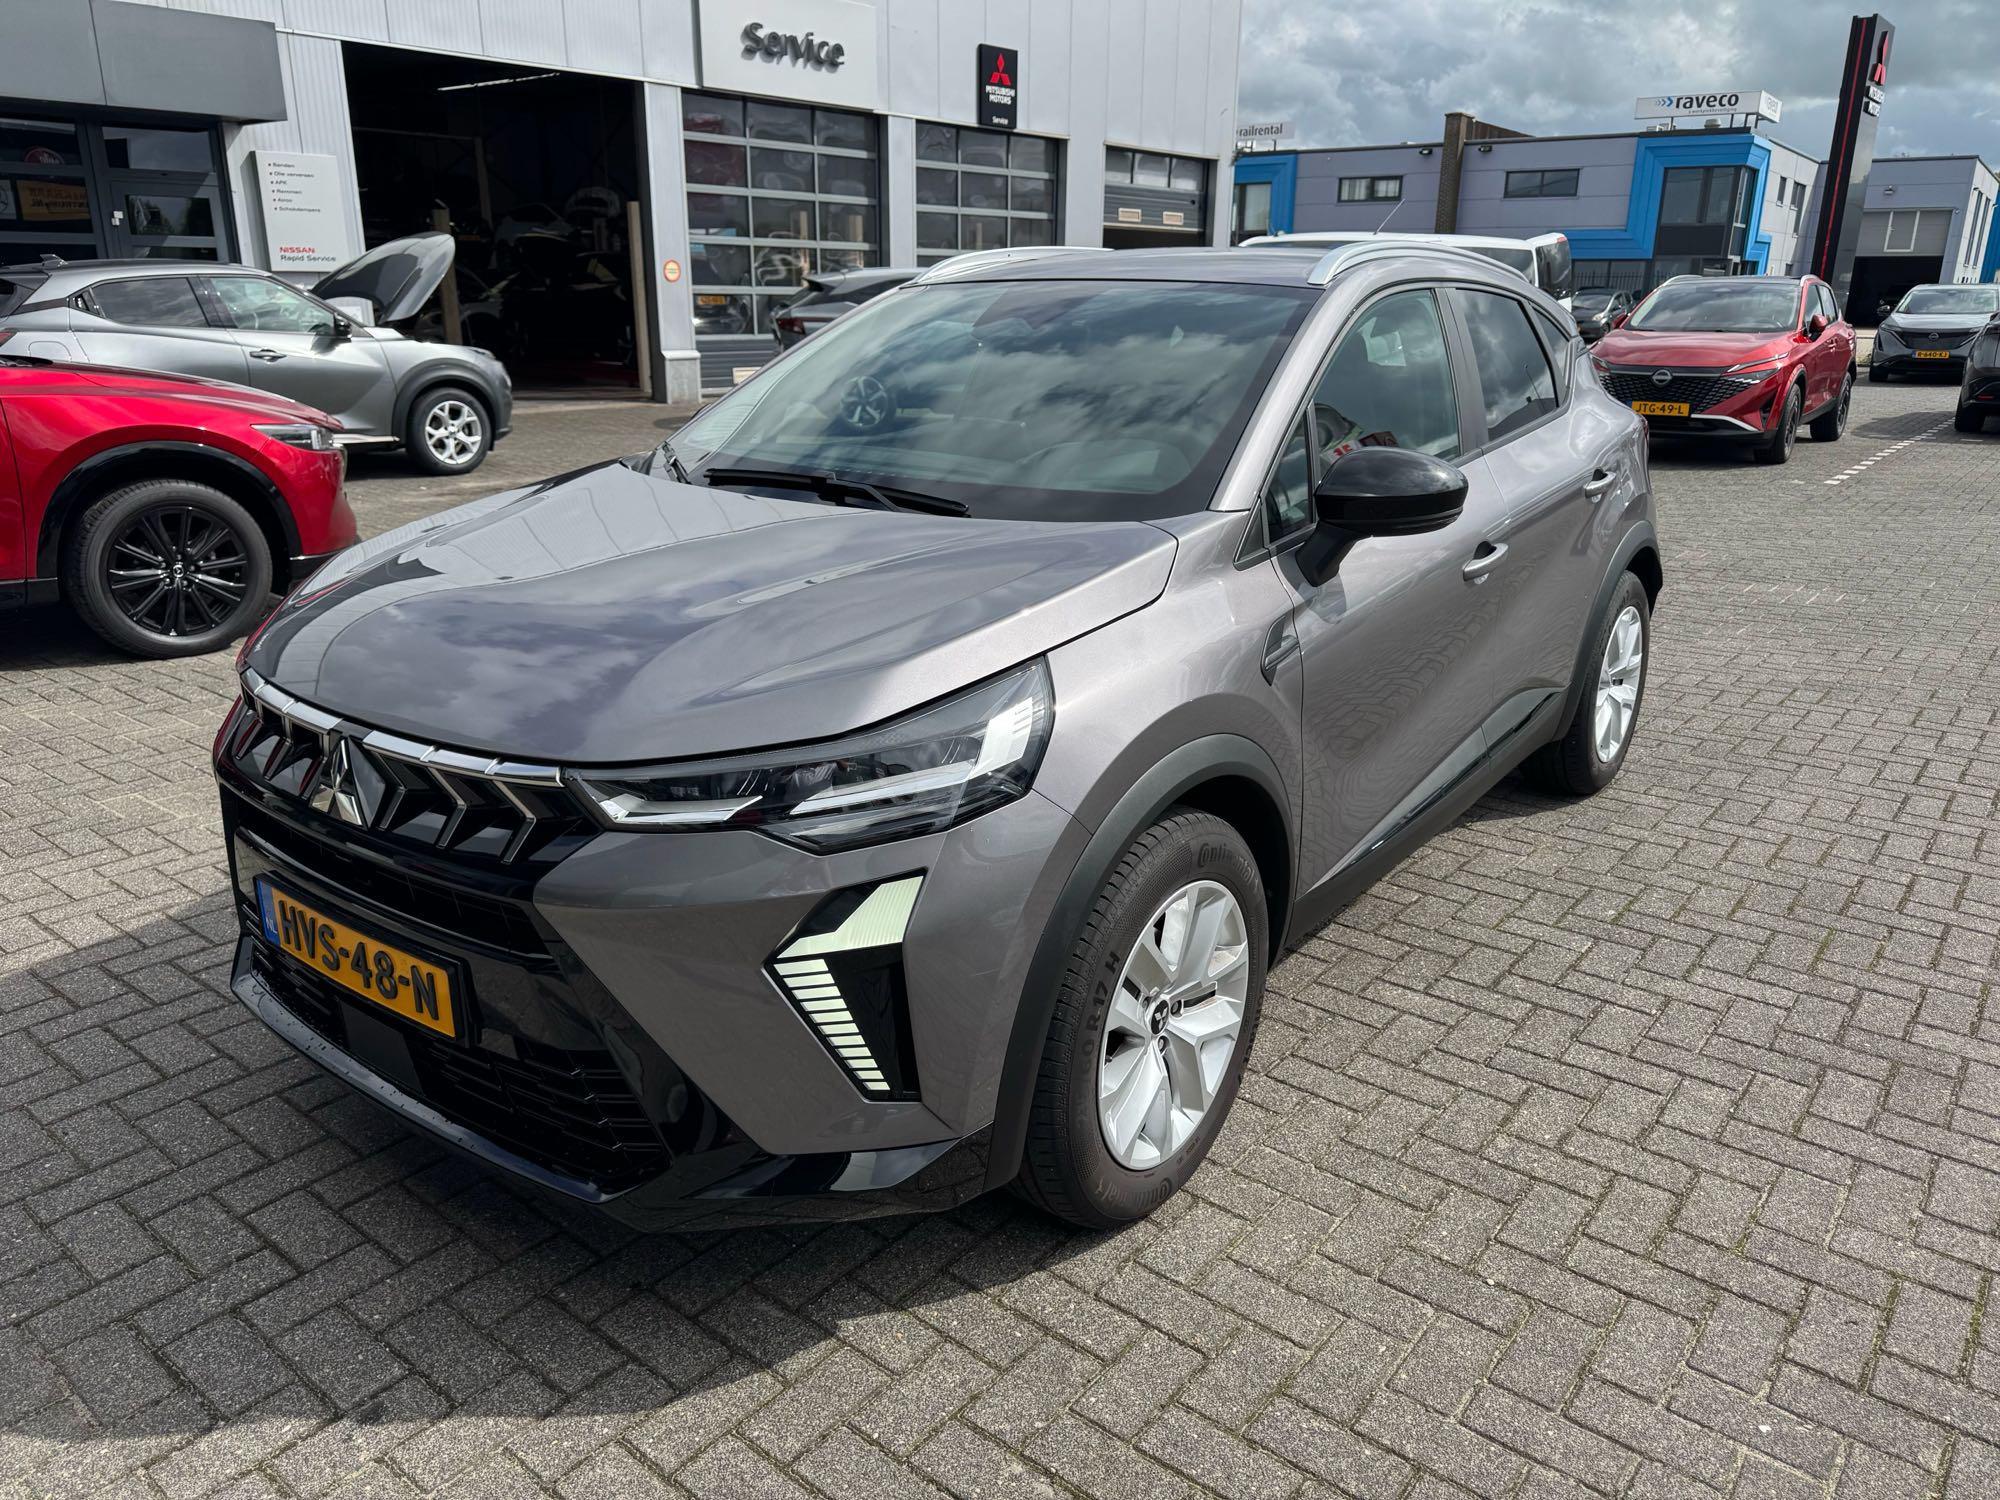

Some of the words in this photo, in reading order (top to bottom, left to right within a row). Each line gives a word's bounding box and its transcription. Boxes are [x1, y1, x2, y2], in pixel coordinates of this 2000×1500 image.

[741, 22, 845, 71] Service
[1675, 93, 1739, 109] raveco
[1239, 123, 1283, 137] railrental
[279, 246, 316, 254] NISSAN
[1635, 403, 1684, 415] JTG-49-L
[278, 900, 440, 1021] HVS-48-N
